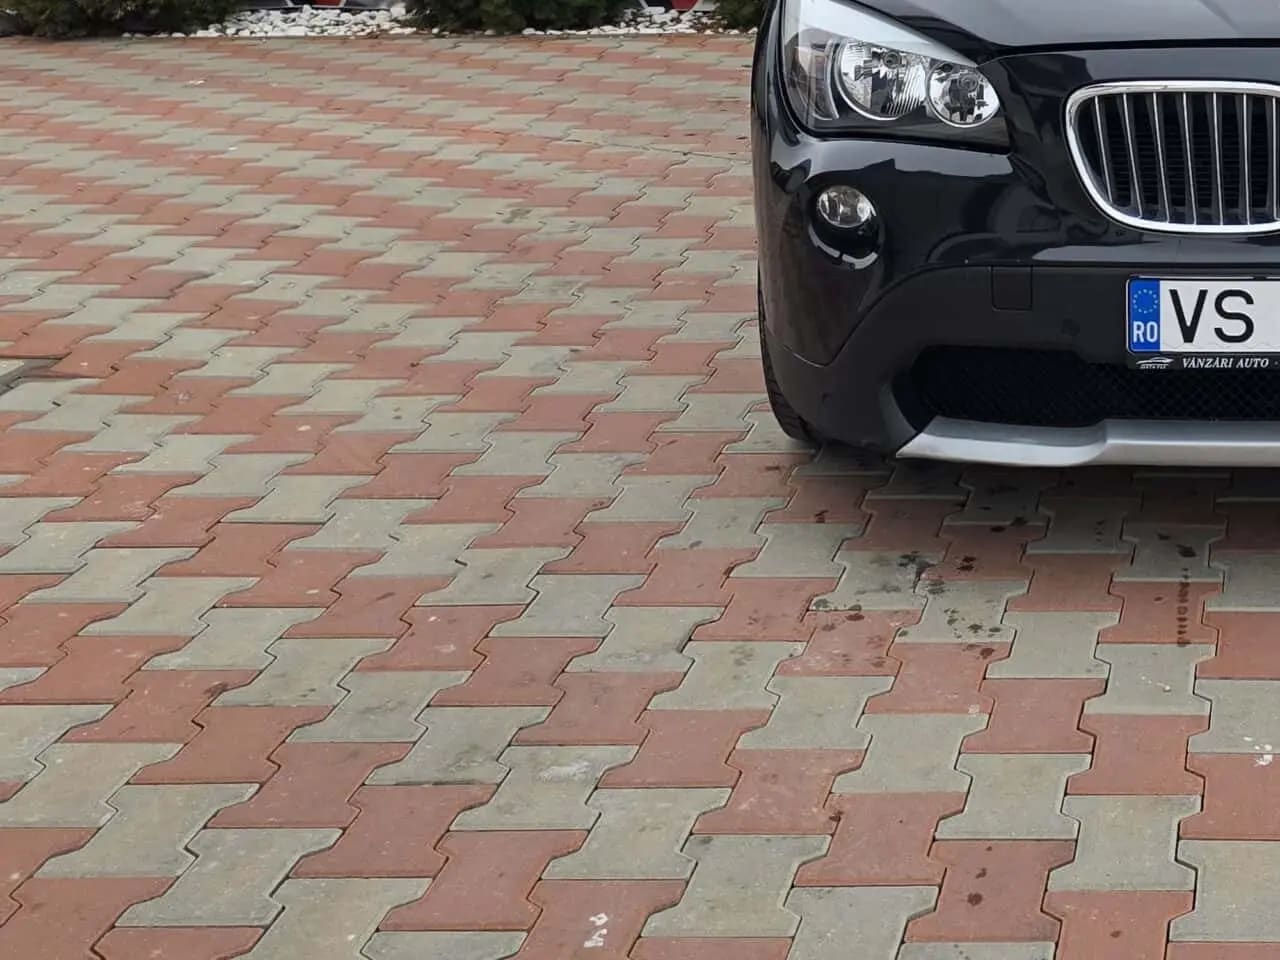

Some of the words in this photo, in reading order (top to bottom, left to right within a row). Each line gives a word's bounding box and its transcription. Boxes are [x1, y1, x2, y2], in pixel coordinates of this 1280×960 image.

[1168, 288, 1255, 344] VS
[1133, 320, 1159, 343] RO
[1236, 357, 1269, 368] AUTO
